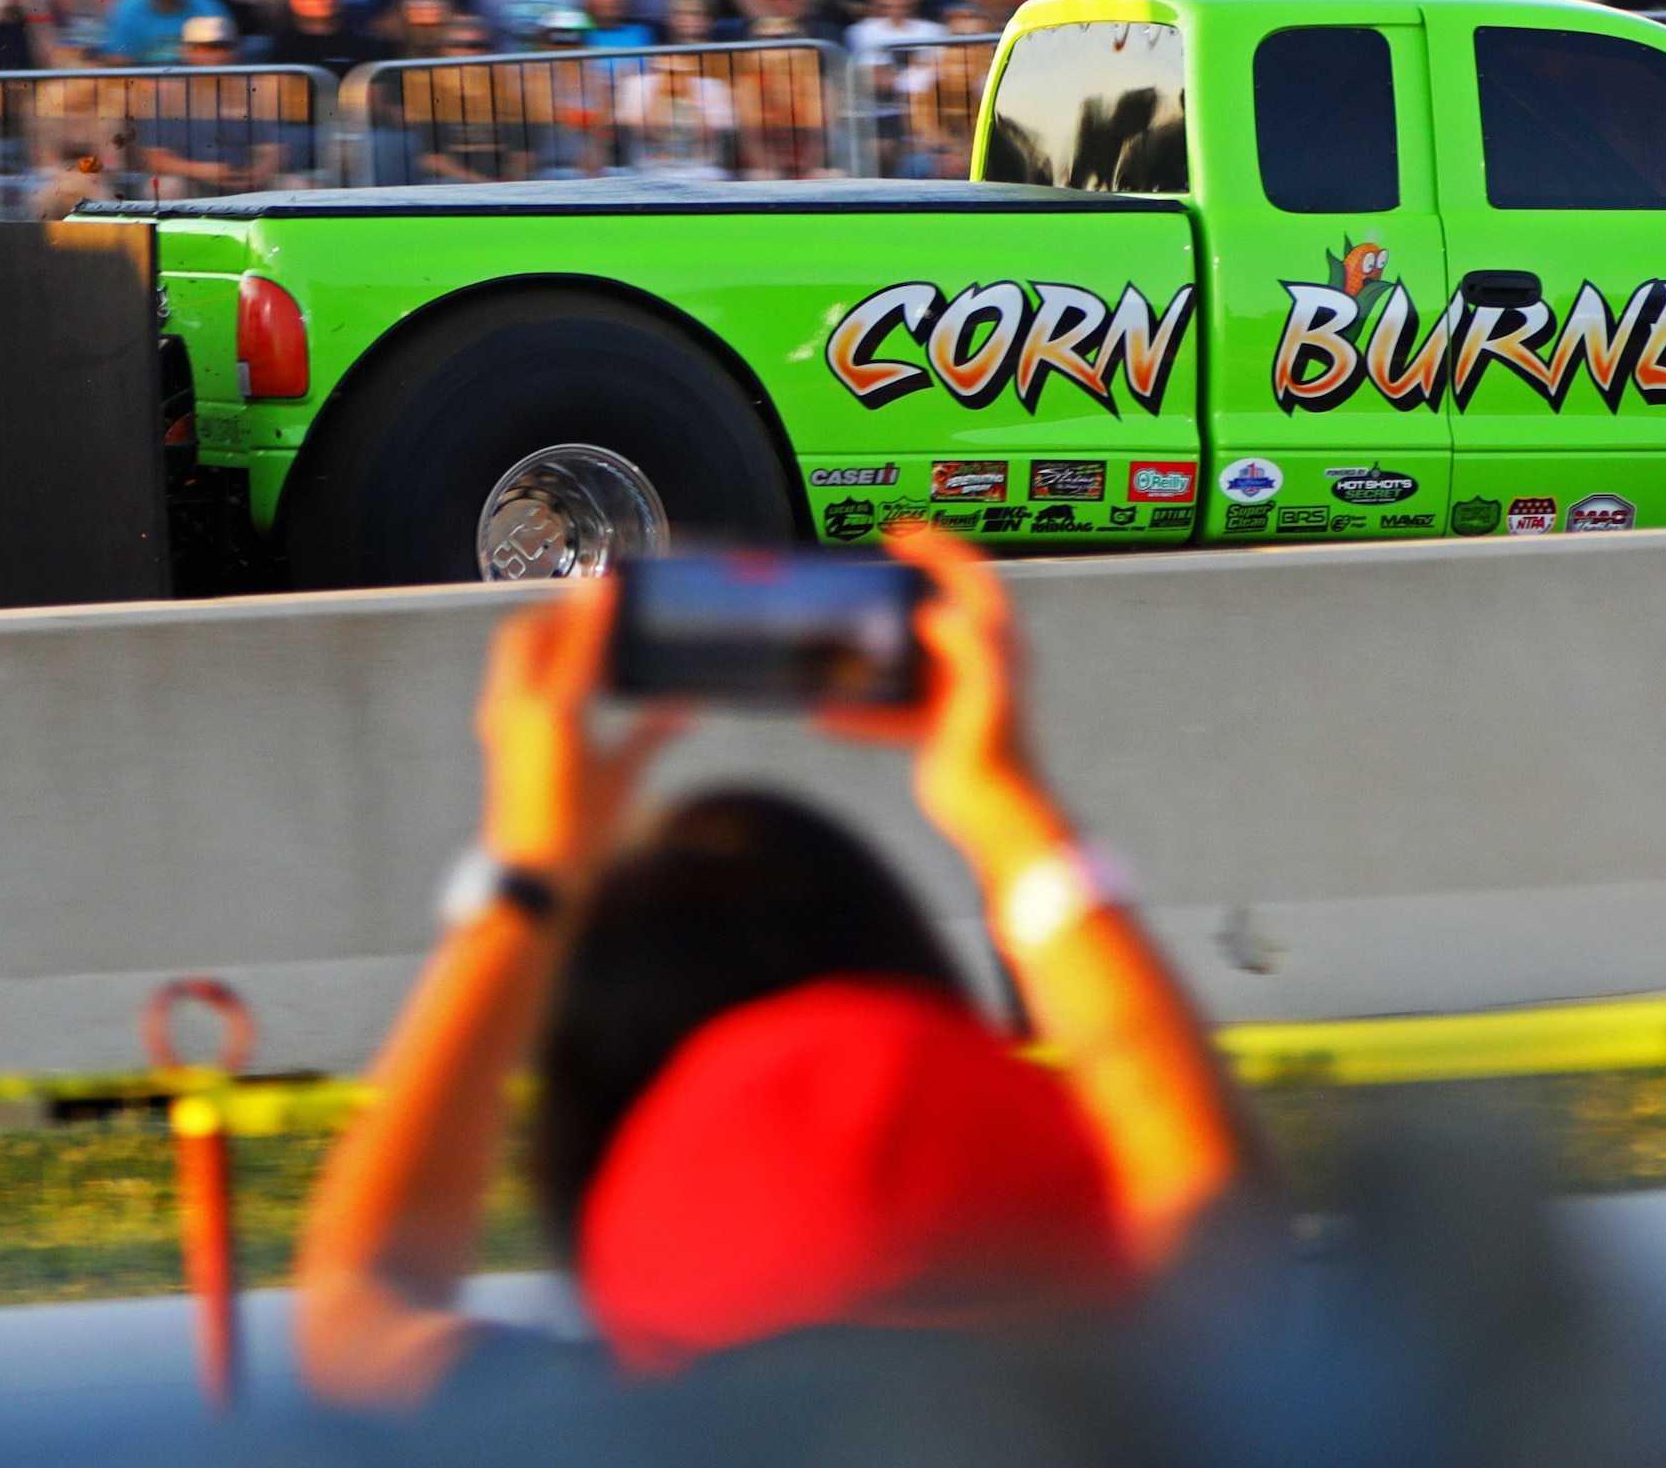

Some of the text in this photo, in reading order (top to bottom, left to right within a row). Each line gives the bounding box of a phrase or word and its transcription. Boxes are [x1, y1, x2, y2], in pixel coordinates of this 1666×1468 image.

[826, 280, 1196, 417] CORN
[1336, 480, 1366, 490] HOT
[1345, 489, 1402, 499] SECRET
[1282, 510, 1325, 524] BRS
[1516, 516, 1546, 529] NTPA
